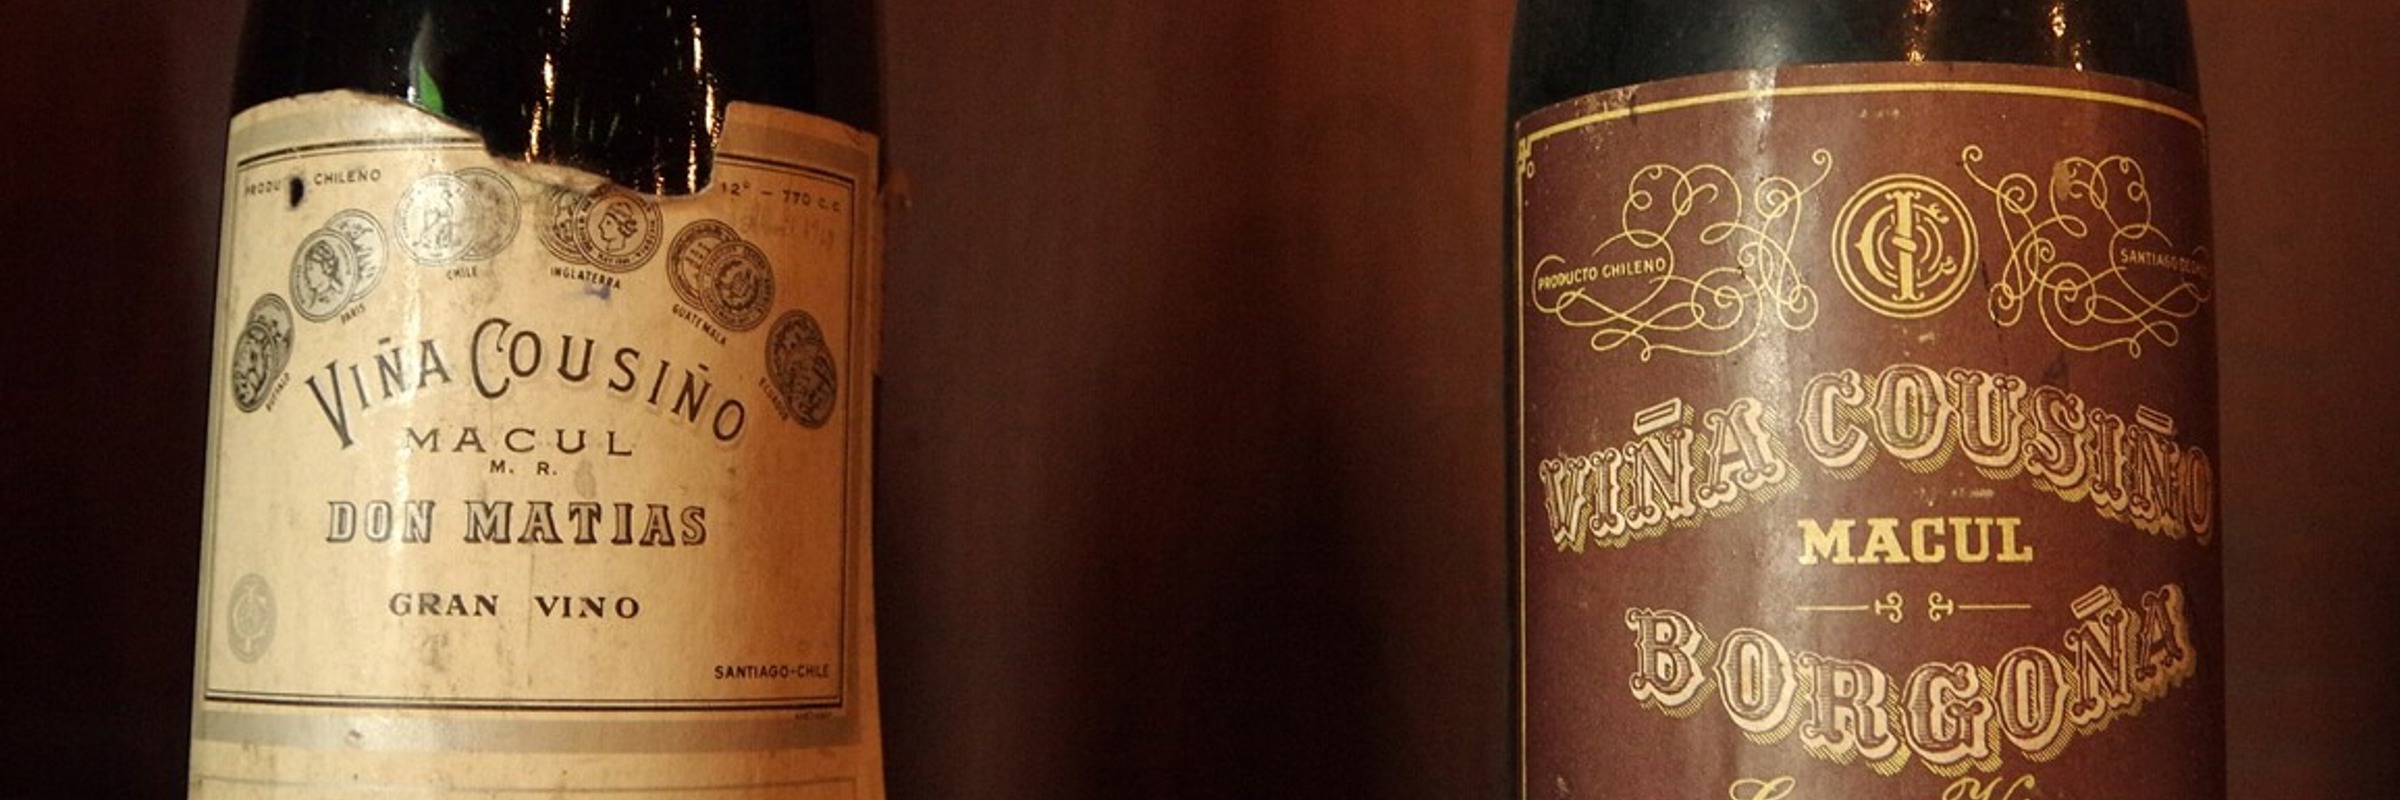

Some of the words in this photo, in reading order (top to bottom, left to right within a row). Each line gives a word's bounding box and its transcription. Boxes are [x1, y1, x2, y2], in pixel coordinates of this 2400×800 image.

[313, 168, 382, 186] CHILENO
[782, 189, 812, 206] 770
[446, 265, 478, 281] CHILE
[550, 266, 621, 289] INGLATERRA
[1537, 266, 1599, 291] PRODUCTO
[1601, 256, 1667, 279] CHILENO
[340, 302, 367, 325] PARIS
[672, 303, 727, 347] GUATEMALA
[405, 426, 634, 456] MACUL
[1539, 396, 1791, 553] VIÑA
[1798, 363, 2216, 545] COUSIÑO
[326, 499, 436, 545] DON
[463, 499, 708, 547] MATIAS
[1798, 516, 2033, 565] MACUL
[388, 592, 499, 618] GRAN
[534, 596, 640, 619] VINO
[1625, 583, 2199, 778] BORGOÑA
